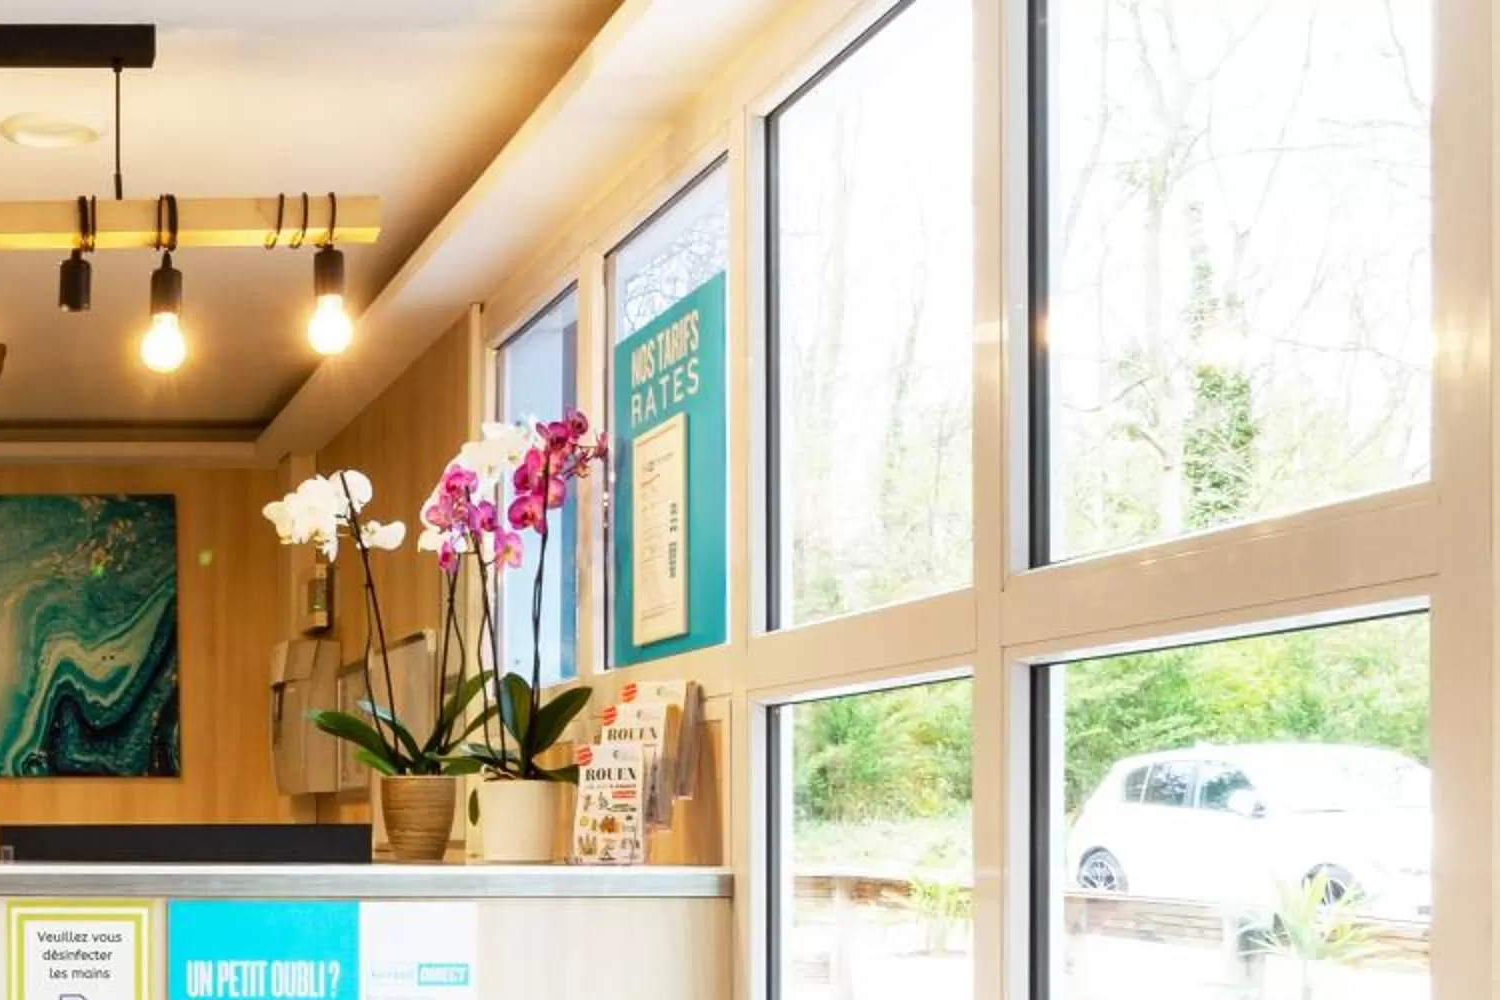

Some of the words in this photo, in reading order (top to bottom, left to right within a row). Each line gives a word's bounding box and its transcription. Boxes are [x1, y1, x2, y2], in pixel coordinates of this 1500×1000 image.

[657, 308, 699, 374] TARIFS
[631, 356, 699, 429] RATES
[37, 930, 89, 943] Veuillez
[91, 932, 123, 943] vous
[42, 949, 113, 961] désinfecter
[49, 967, 68, 979] les
[71, 967, 111, 979] mains
[187, 959, 213, 998] UN
[217, 959, 268, 998] PETIT
